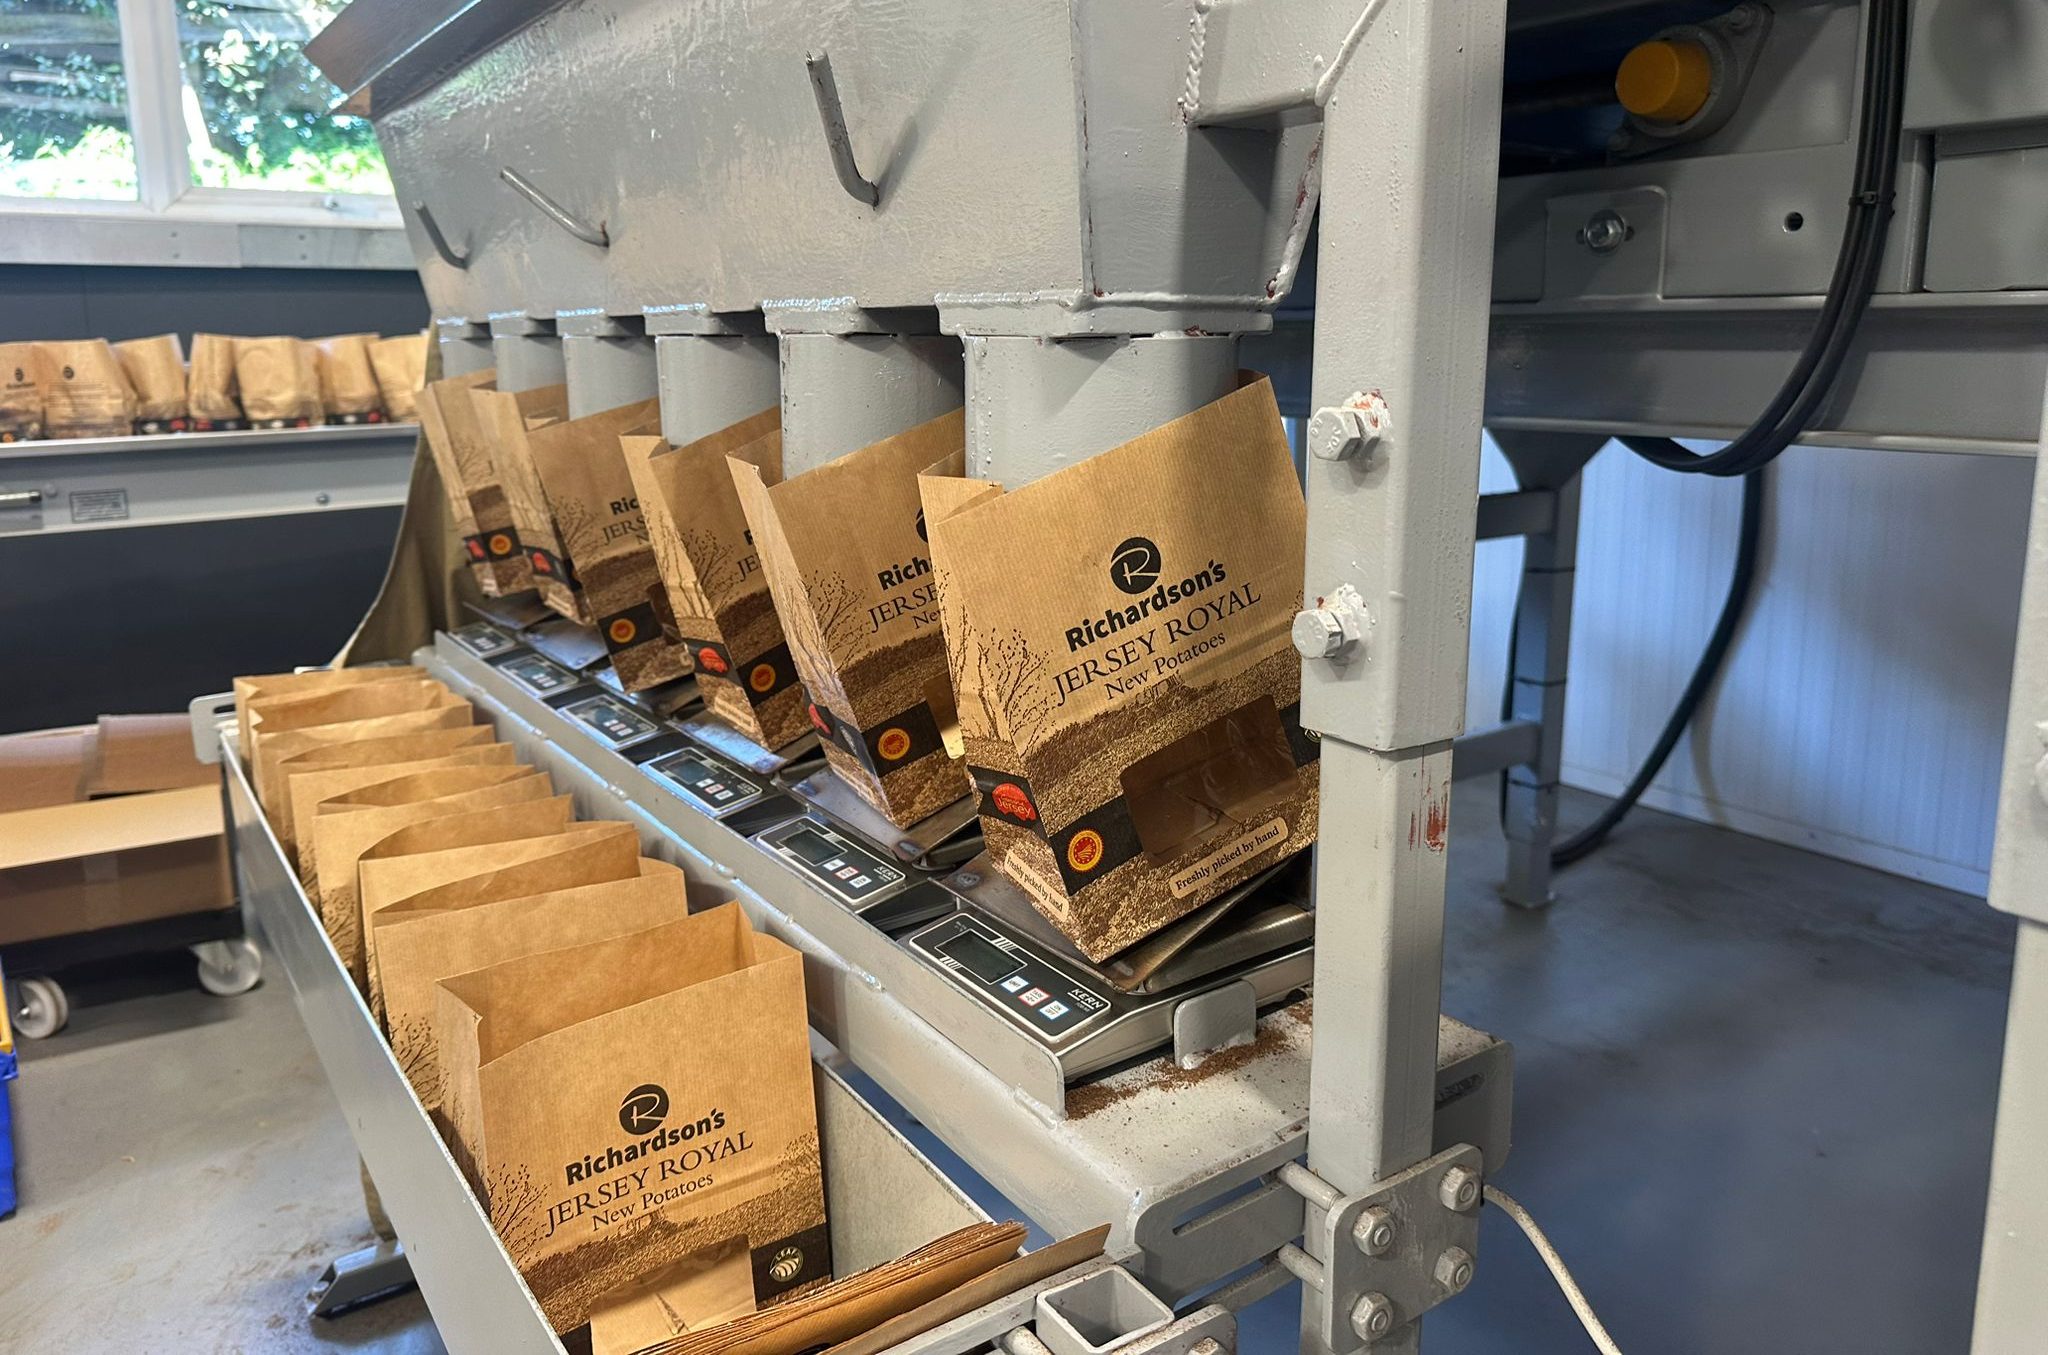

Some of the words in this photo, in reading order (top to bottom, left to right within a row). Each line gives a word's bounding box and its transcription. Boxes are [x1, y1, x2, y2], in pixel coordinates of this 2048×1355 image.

[602, 516, 647, 546] JERS
[867, 581, 939, 633] JERSE
[1065, 559, 1227, 653] Richardson's
[1052, 629, 1157, 707] JERSEY
[1164, 582, 1262, 645] ROYAL
[1104, 671, 1148, 700] New
[1154, 631, 1227, 676] Potatoes
[998, 797, 1032, 818] Jersey
[1006, 857, 1025, 879] Freshly
[1024, 874, 1042, 894] picked
[1049, 893, 1064, 912] hand
[1175, 864, 1212, 891] Freshly
[1211, 845, 1242, 875] picked
[1241, 841, 1255, 858] by
[1254, 826, 1280, 850] hand
[1071, 988, 1104, 1009] KERN
[566, 1108, 726, 1187] Richardson's
[545, 1167, 650, 1238] JERSEY
[659, 1131, 754, 1182] ROYAL
[592, 1203, 635, 1232] New
[642, 1174, 714, 1210] Potatoes
[775, 1247, 799, 1261] LEAF
